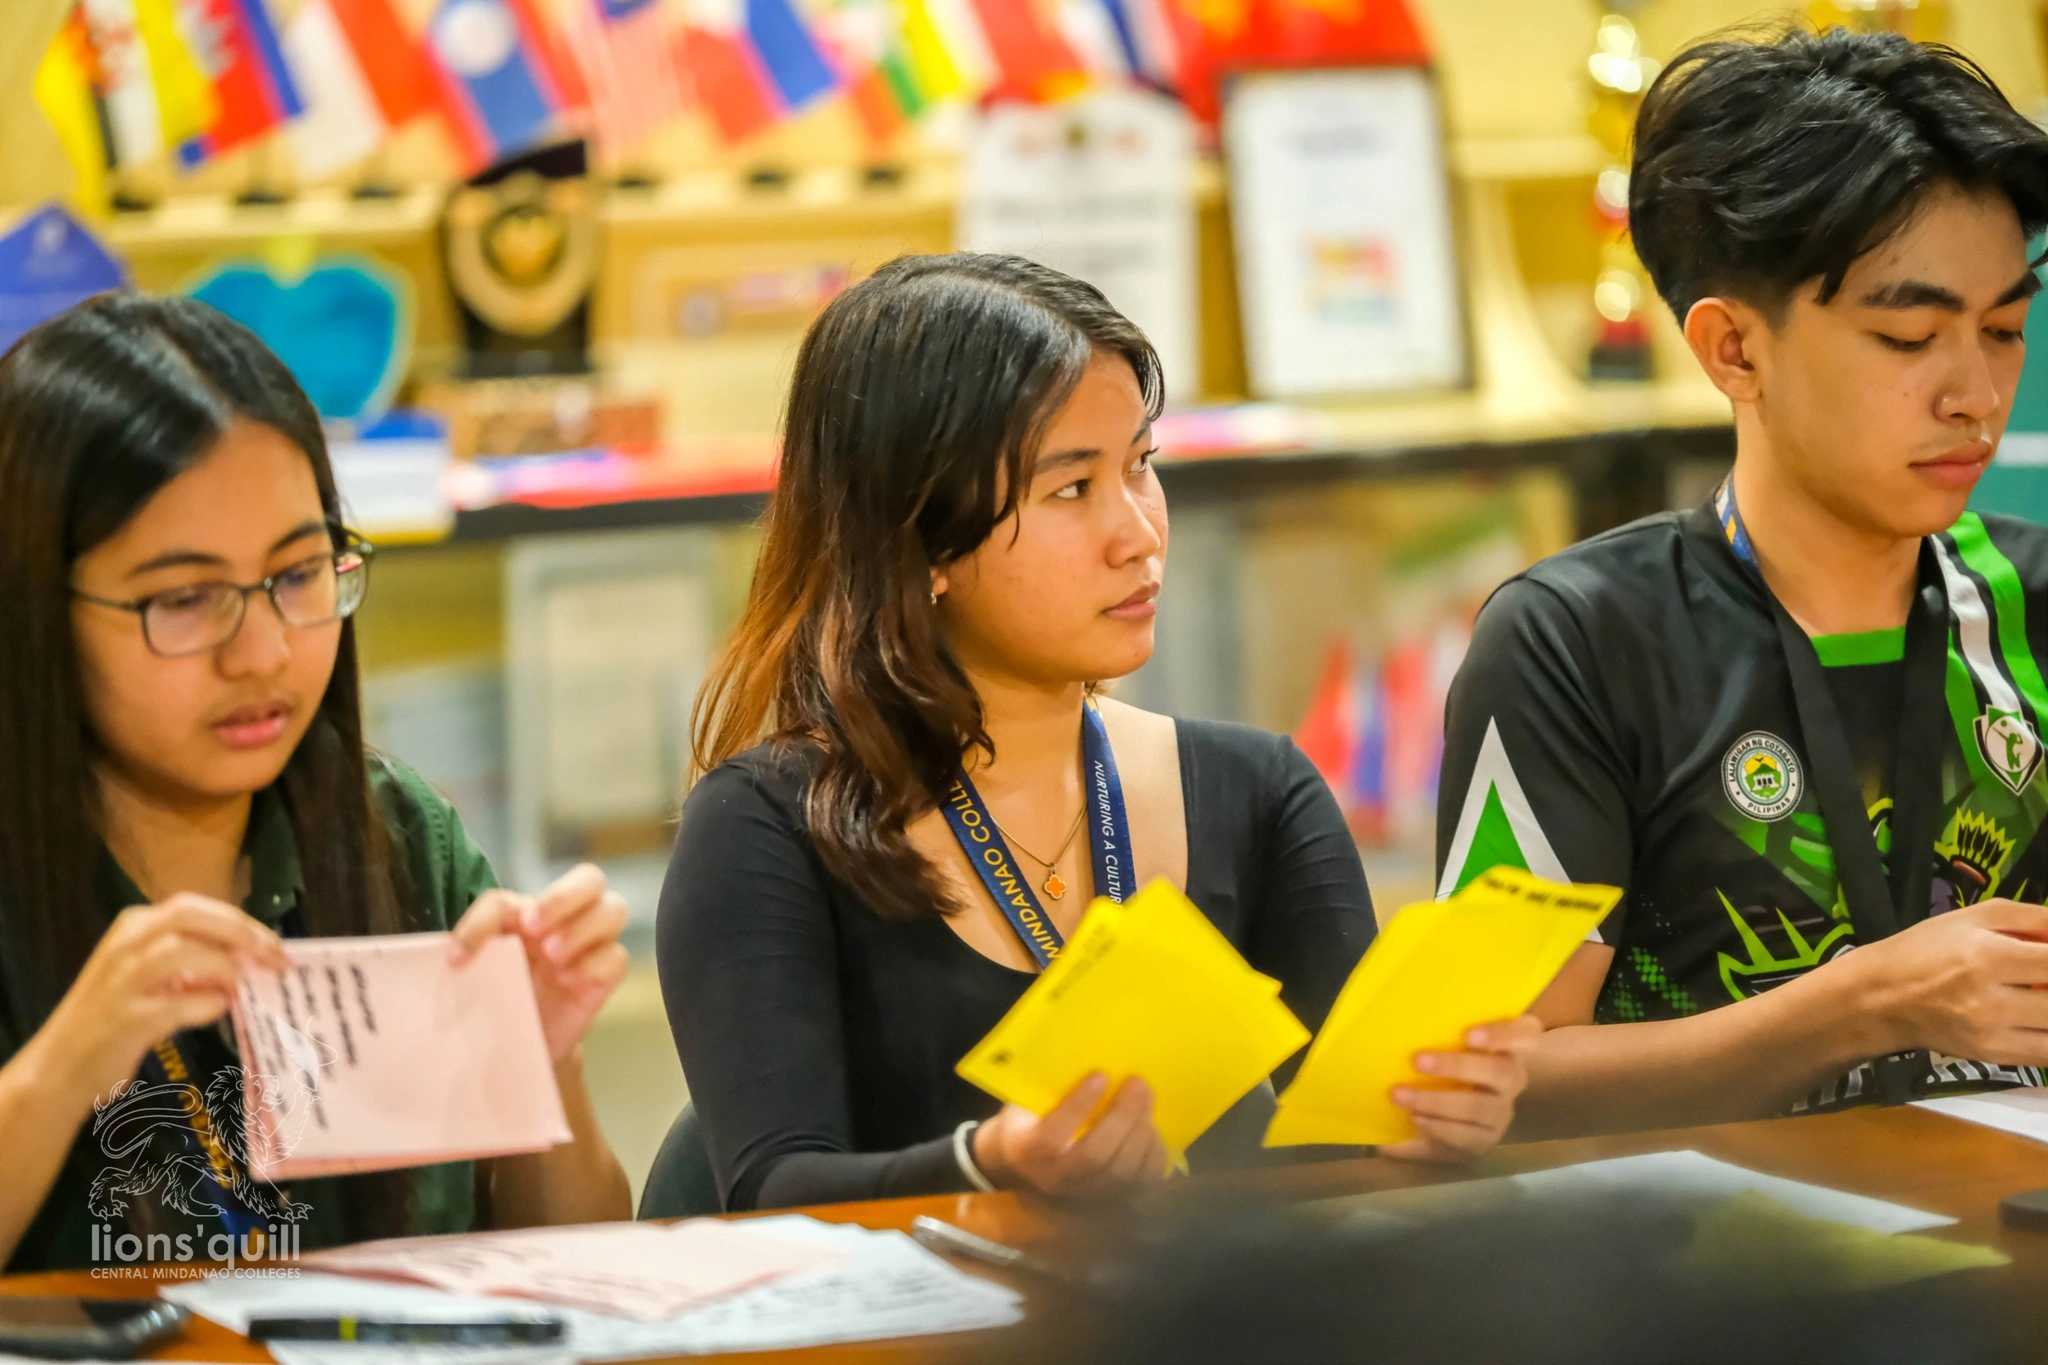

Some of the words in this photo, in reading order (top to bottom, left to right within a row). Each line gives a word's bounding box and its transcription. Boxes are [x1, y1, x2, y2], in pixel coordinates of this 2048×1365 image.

[1729, 742, 1751, 782] LALAWIGAN
[1752, 739, 1763, 747] NG
[1764, 740, 1796, 773] COTABATO
[1094, 760, 1114, 837] NURTURING
[1747, 797, 1791, 814] PILIPINAS
[1103, 840, 1116, 850] A
[984, 848, 1064, 959] MINDANAO
[1105, 854, 1122, 906] CULTUR
